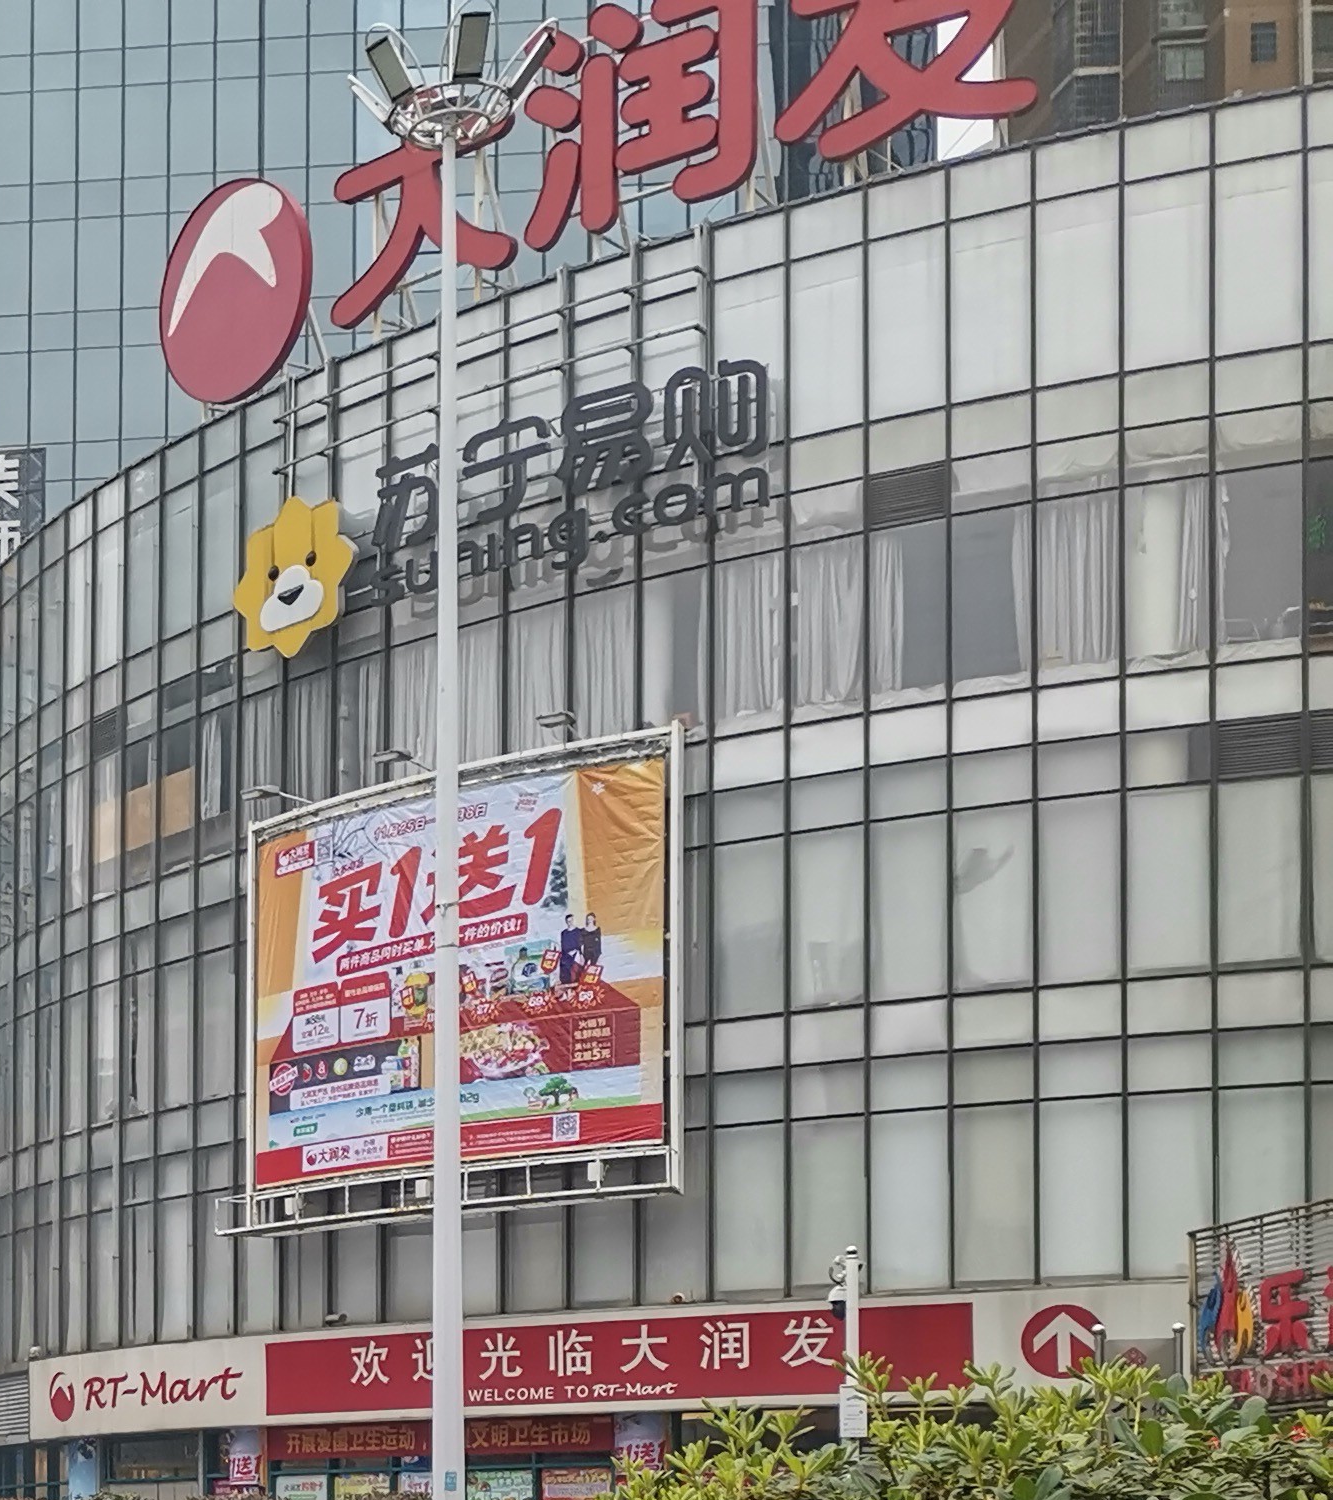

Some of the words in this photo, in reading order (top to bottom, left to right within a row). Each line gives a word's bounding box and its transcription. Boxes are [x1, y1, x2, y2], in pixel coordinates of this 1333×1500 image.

[83, 1366, 244, 1412] RT-Mart
[468, 1386, 555, 1402] WELCOME
[565, 1385, 590, 1399] TO
[592, 1381, 679, 1398] RT-Mart
